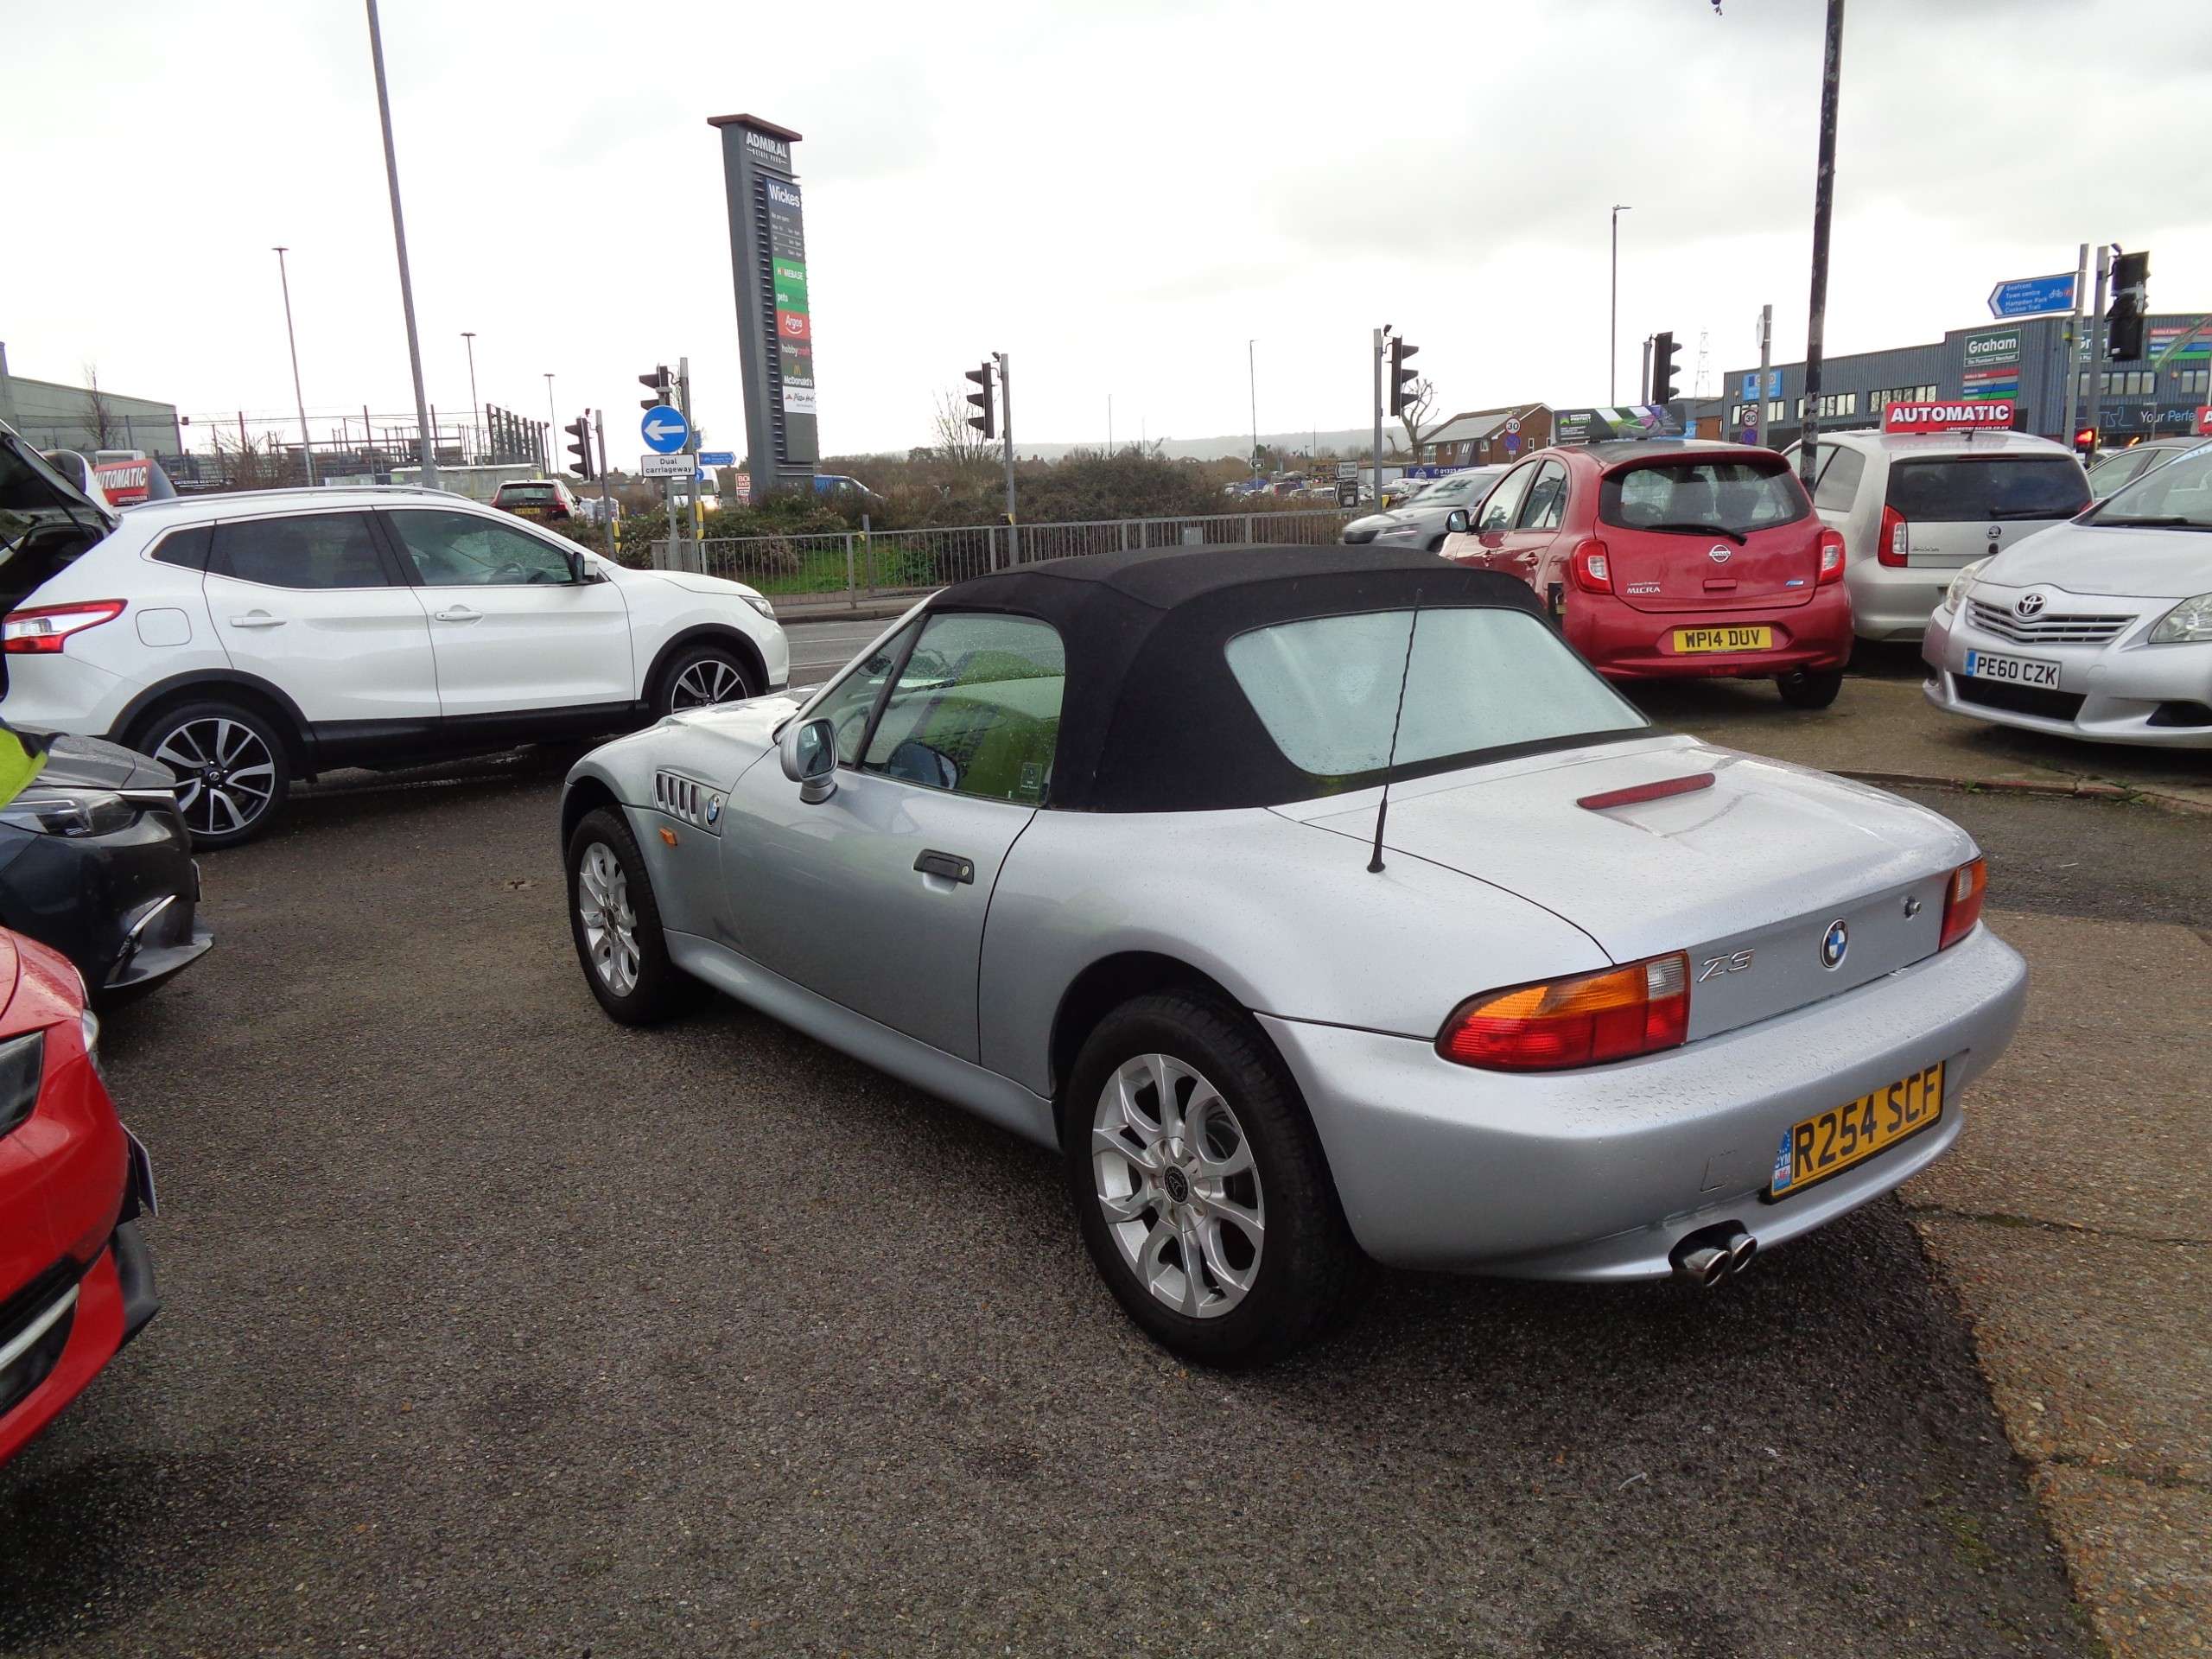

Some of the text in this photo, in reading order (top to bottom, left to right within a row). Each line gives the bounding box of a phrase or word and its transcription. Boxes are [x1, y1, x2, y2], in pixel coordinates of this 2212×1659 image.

[746, 131, 787, 158] ADMIRAL
[768, 184, 800, 208] Wickes
[778, 267, 804, 281] HOMEBASE
[2005, 283, 2032, 291] Seafront
[777, 292, 788, 303] pets
[2005, 298, 2033, 307] Hampden
[785, 315, 803, 330] Argos
[1968, 338, 2017, 354] Graham
[784, 375, 813, 387] McDonald's
[1891, 404, 2009, 423] AUTOMATIC
[2139, 410, 2164, 423] Your
[1507, 422, 1519, 430] 30
[645, 466, 692, 474] carriageway
[1684, 629, 1760, 648] WP14 DUV
[1976, 656, 2057, 685] PE60 CZK
[1793, 1064, 1939, 1179] R254 SCF
[1774, 1152, 1790, 1168] CYM
